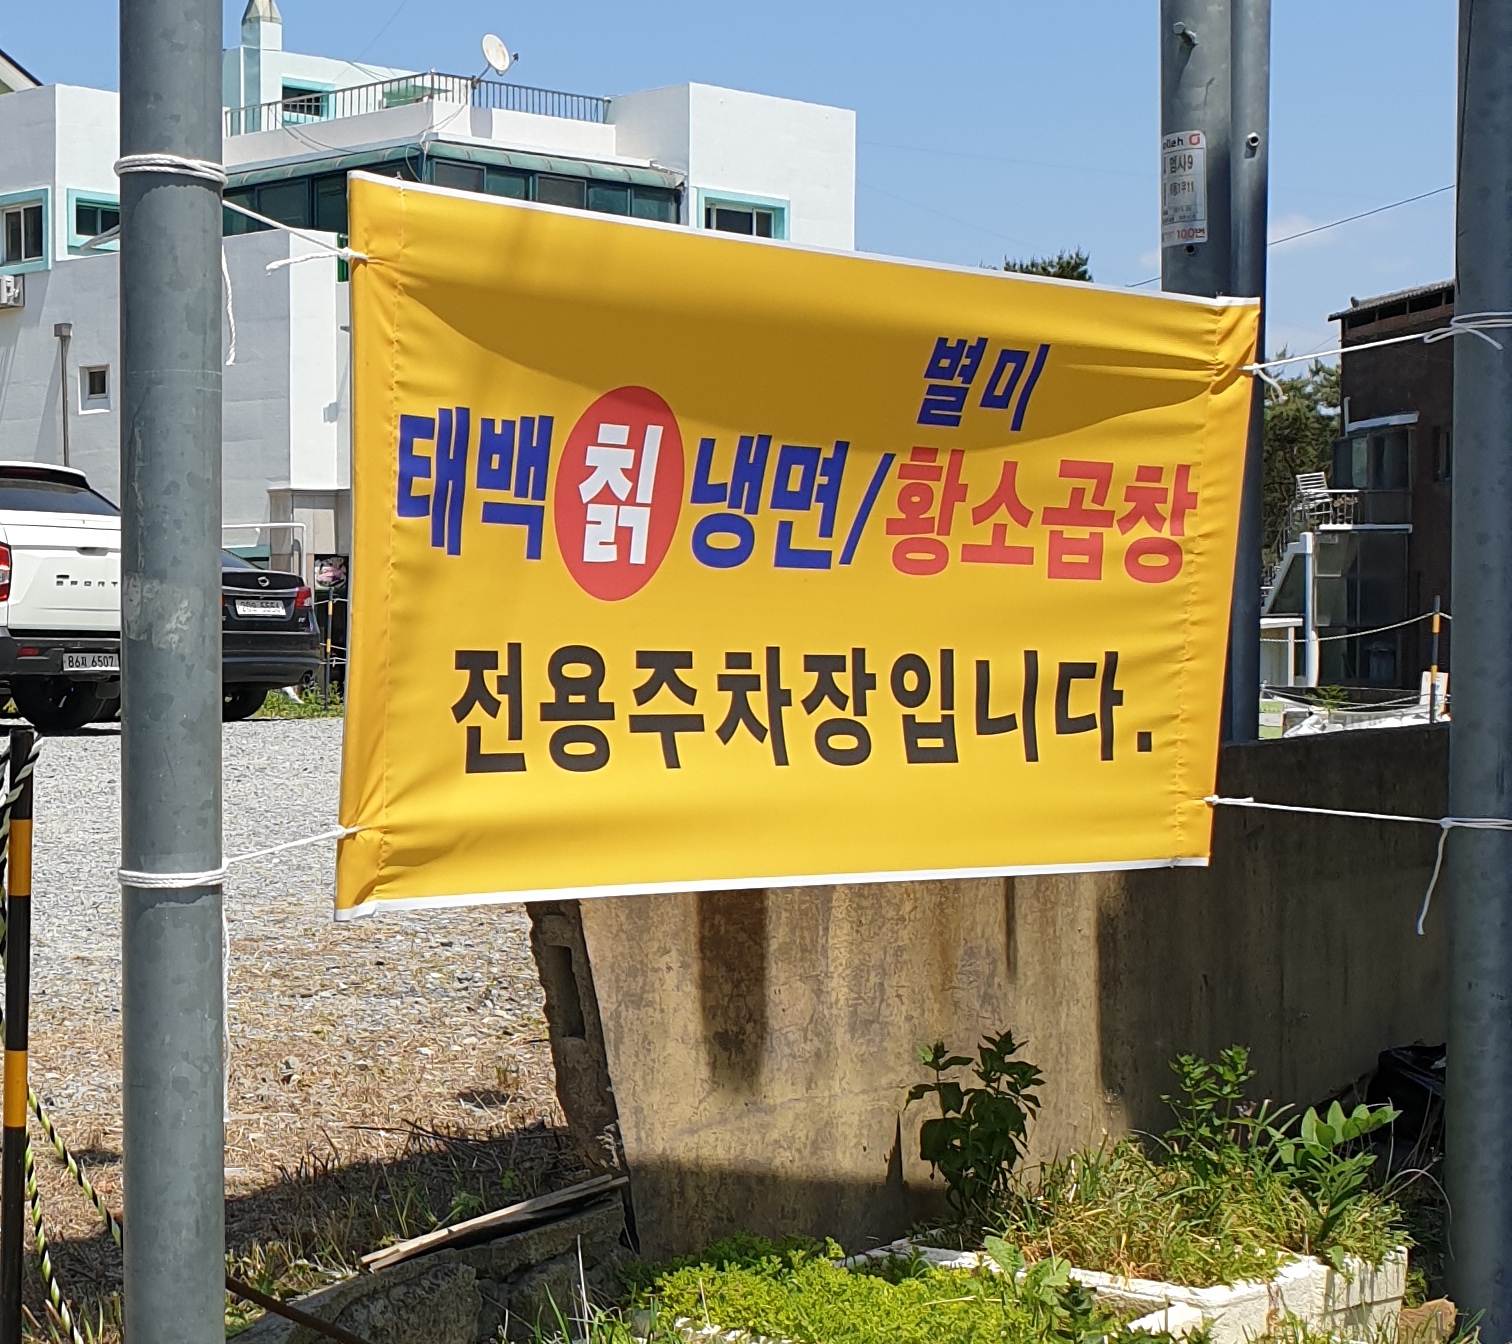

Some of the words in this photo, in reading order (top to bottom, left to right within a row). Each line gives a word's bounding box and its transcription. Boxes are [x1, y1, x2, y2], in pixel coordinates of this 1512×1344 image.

[917, 336, 1051, 433] 별미
[91, 655, 114, 667] 6507
[451, 642, 1154, 776] 전용주차장입니다.
